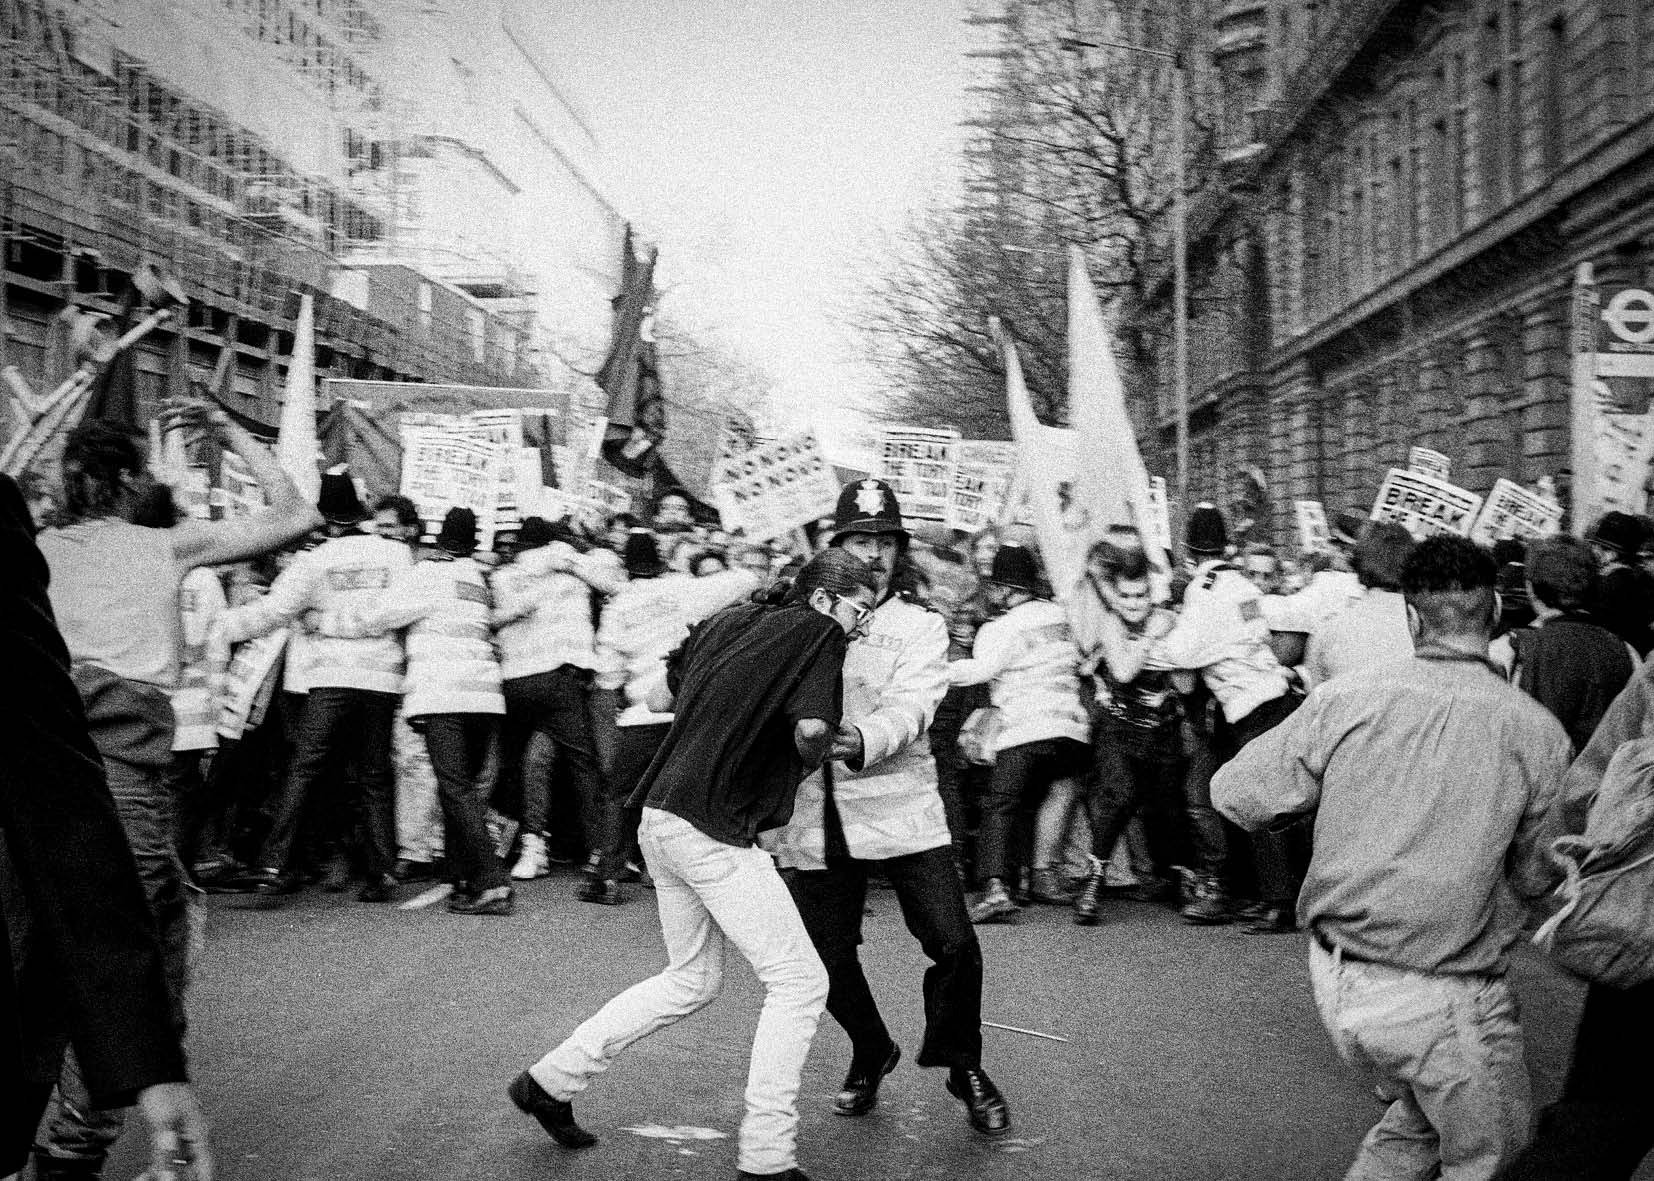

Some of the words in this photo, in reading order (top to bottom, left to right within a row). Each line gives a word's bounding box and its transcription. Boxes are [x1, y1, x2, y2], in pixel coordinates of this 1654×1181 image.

[883, 442, 947, 461] BREAK
[1384, 487, 1465, 531] BREAK
[1496, 494, 1547, 526] BREAK
